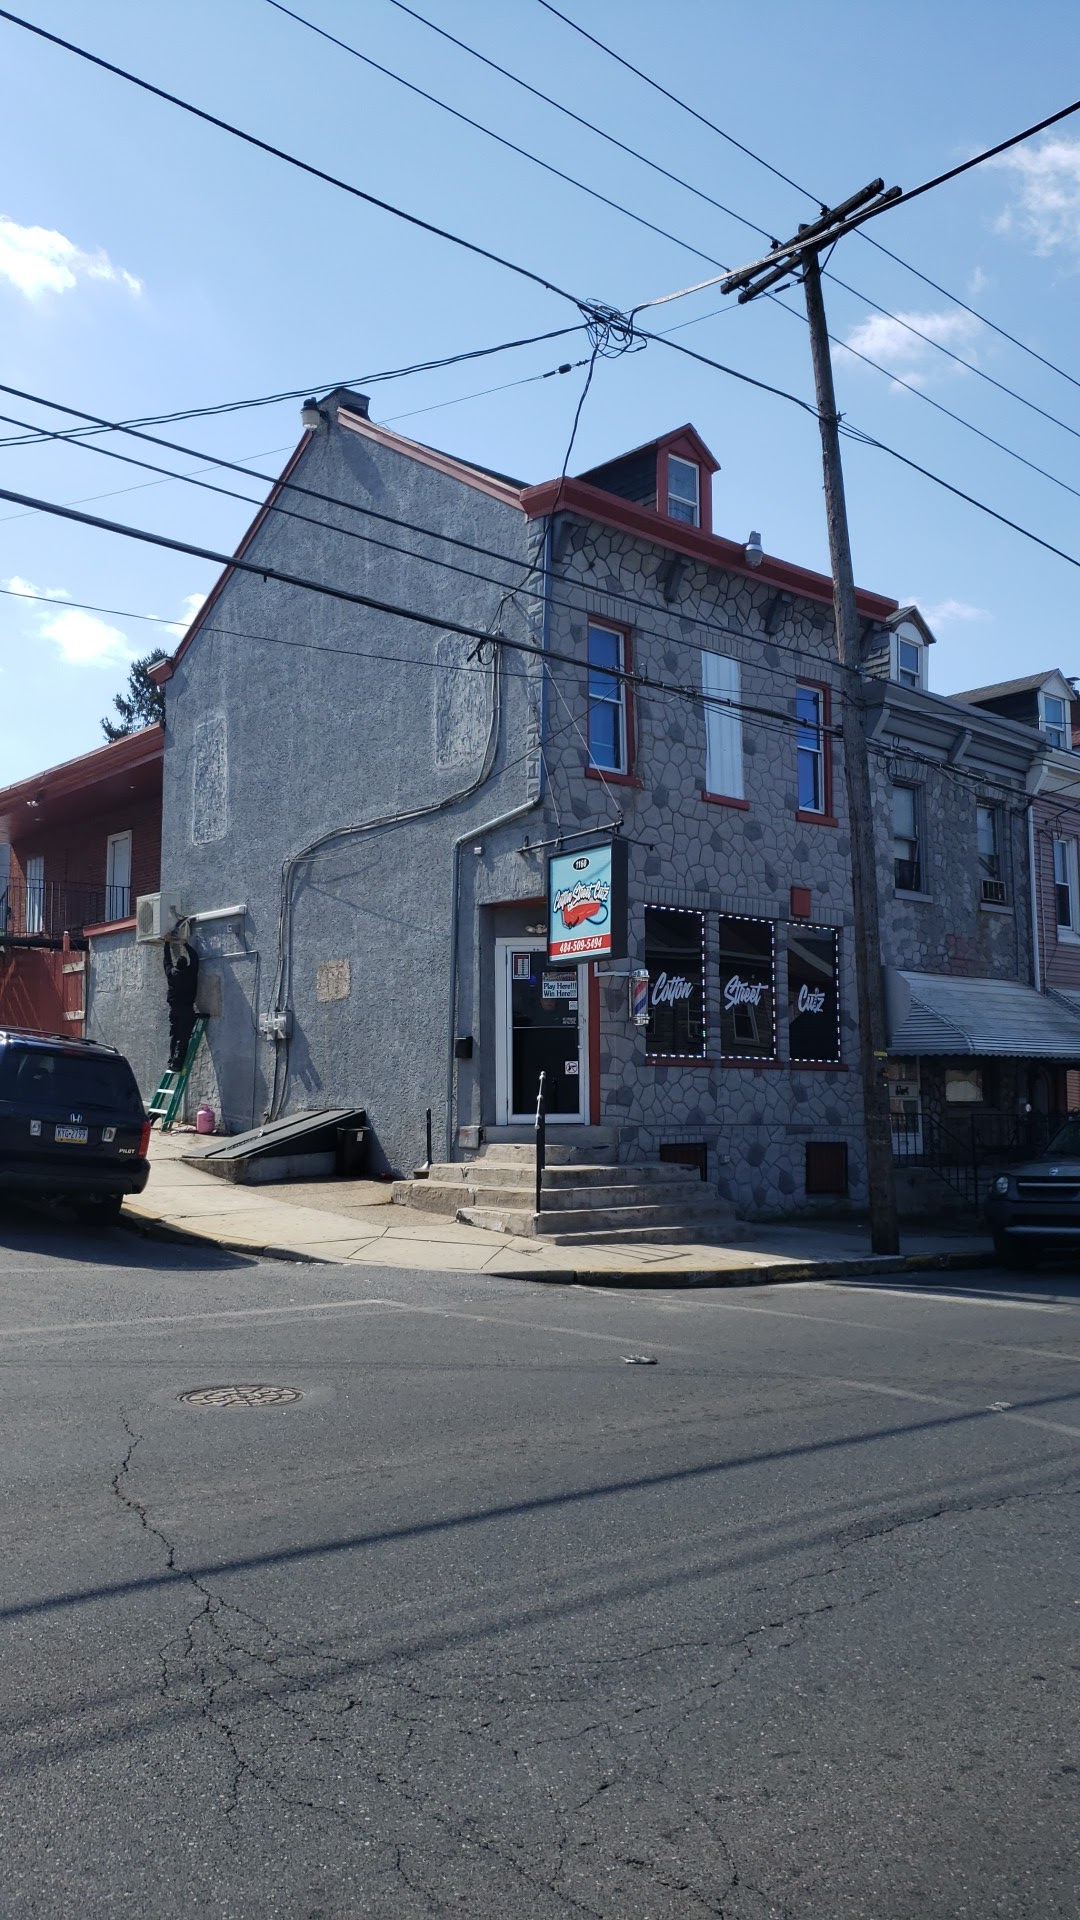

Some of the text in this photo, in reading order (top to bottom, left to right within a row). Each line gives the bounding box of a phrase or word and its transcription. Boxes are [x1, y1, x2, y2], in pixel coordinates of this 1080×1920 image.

[553, 880, 610, 912] Cotton Street Cutz
[543, 982, 556, 990] Play
[651, 972, 826, 1013] Cotton Street Cutz
